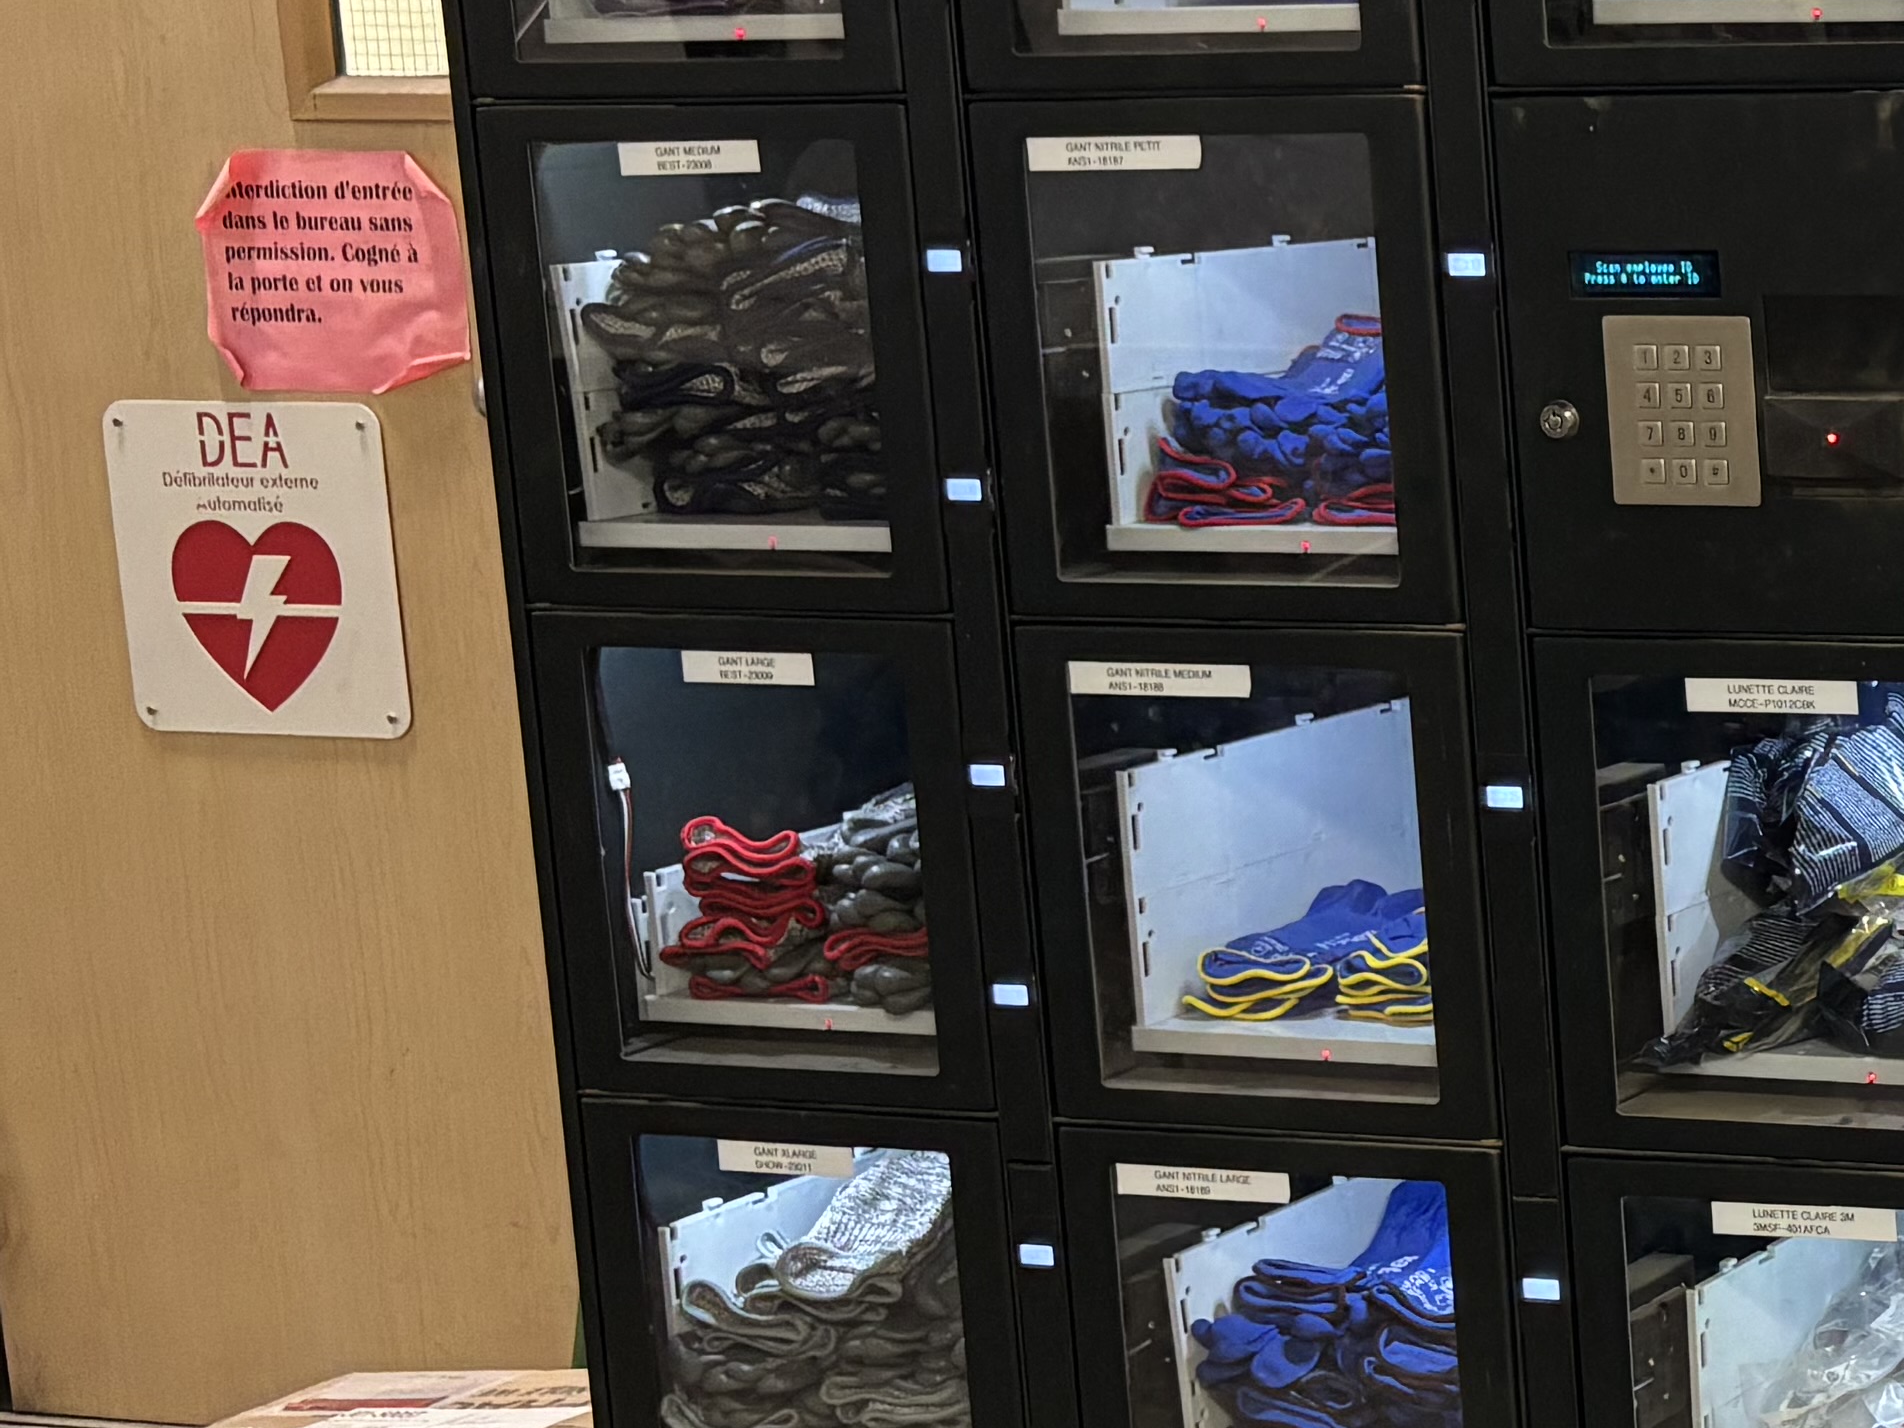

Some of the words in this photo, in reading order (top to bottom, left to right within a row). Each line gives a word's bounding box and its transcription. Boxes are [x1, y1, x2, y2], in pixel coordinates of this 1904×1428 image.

[225, 180, 327, 200] nterdiction
[335, 180, 412, 201] d'entrée
[223, 211, 266, 230] dans
[273, 211, 289, 230] le
[296, 211, 362, 231] bureau
[369, 216, 413, 232] sans
[225, 241, 335, 264] permission.
[342, 242, 400, 267] Cogné
[408, 243, 418, 263] à
[1680, 261, 1693, 274] ID
[228, 272, 244, 291] la
[251, 275, 298, 295] porte
[305, 276, 322, 292] et
[330, 278, 353, 293] on
[360, 279, 403, 293] vous
[1584, 272, 1615, 285] Press
[1632, 272, 1646, 285] to
[1687, 272, 1700, 285] ID
[231, 302, 322, 326] répondra.
[196, 412, 288, 468] DEA
[260, 473, 319, 489] externe
[1106, 667, 1132, 677] GANT
[1727, 684, 1774, 694] LUNETTE
[1752, 1209, 1798, 1220] LUNETTE
